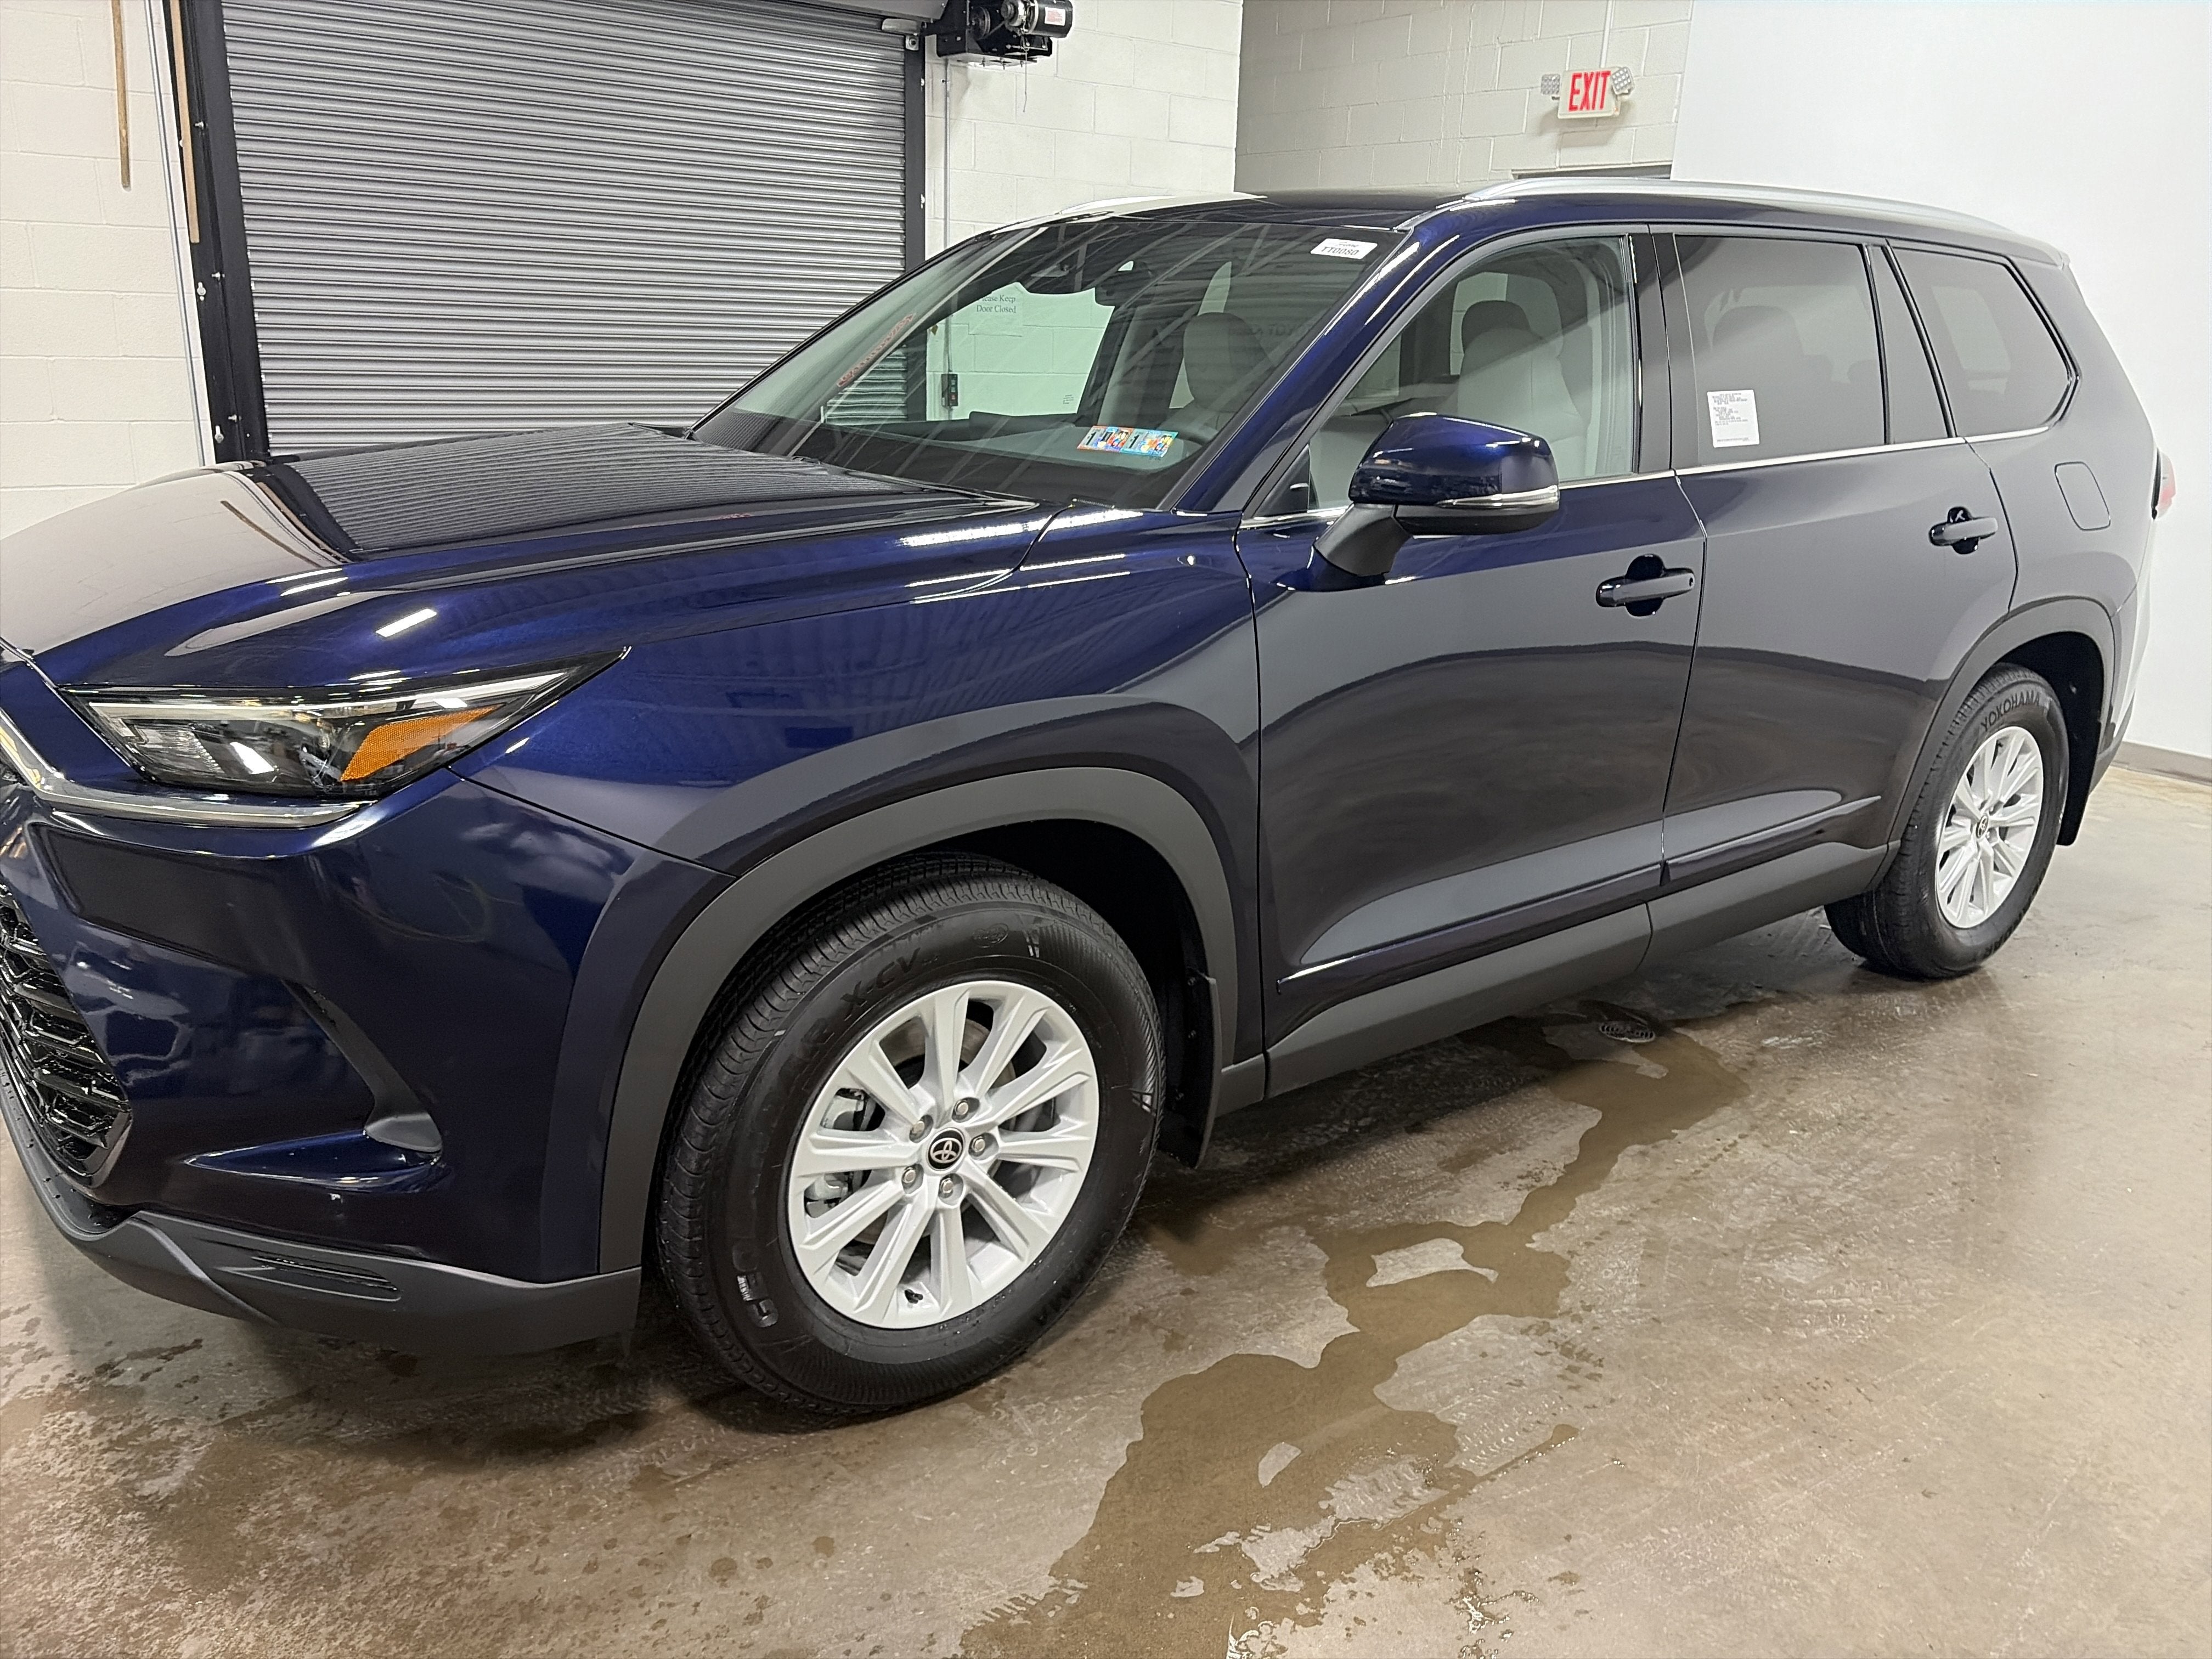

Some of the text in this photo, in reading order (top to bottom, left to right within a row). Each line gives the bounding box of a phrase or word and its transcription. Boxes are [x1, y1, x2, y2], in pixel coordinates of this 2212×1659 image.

[1568, 70, 1611, 112] EXIT
[994, 305, 1016, 313] Closed
[1000, 295, 1016, 303] Keep
[1980, 690, 2040, 732] YOKOHAMA
[839, 945, 921, 1022] X-CV
